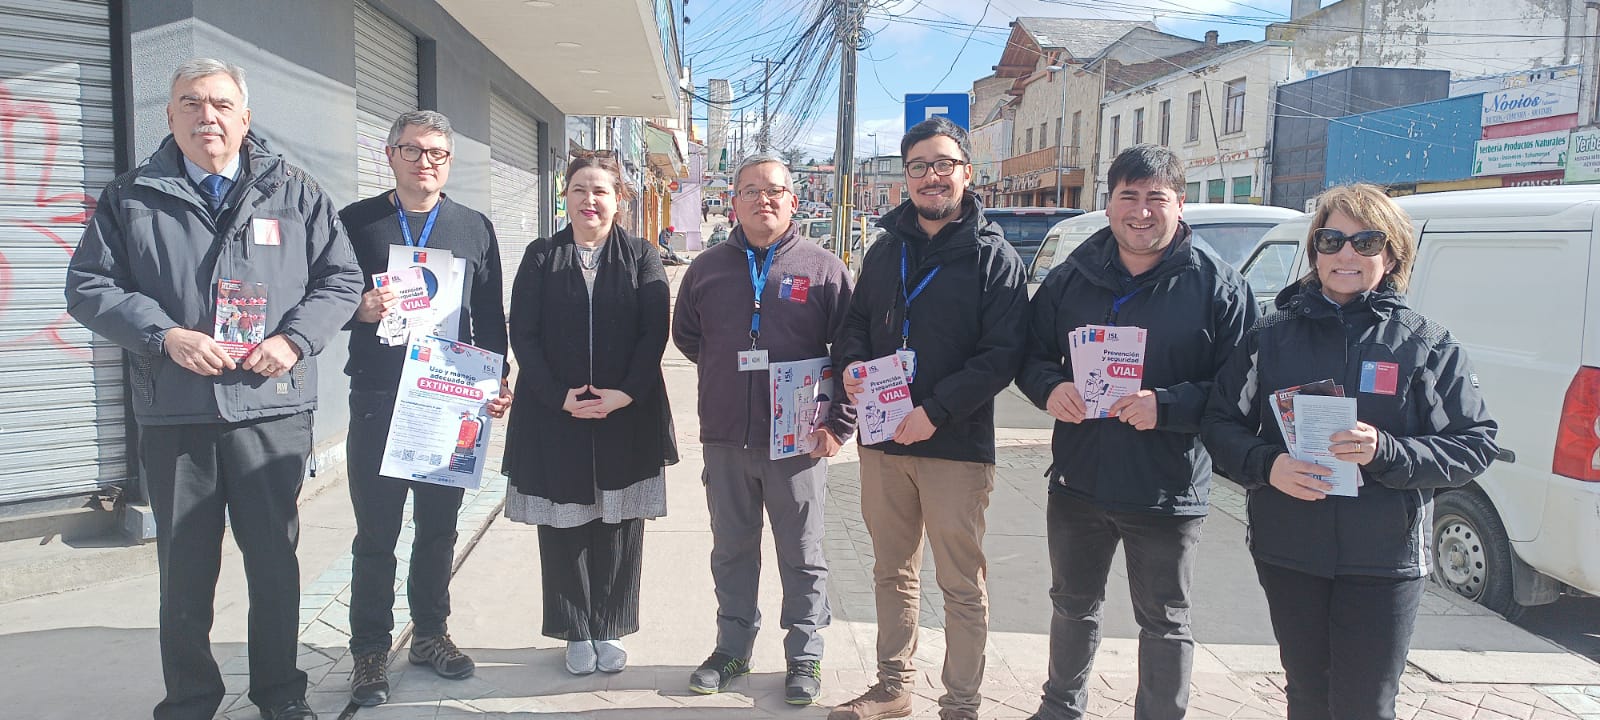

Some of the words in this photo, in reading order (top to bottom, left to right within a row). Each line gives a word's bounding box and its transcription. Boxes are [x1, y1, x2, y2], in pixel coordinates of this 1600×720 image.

[1485, 93, 1541, 113] Novios
[1504, 140, 1533, 151] Productos
[1535, 136, 1566, 148] Naturales
[403, 299, 427, 310] VIAL
[1103, 349, 1139, 358] Prevención
[1107, 356, 1139, 364] seguridad
[429, 365, 443, 374] Uso
[450, 370, 477, 382] manejo
[483, 364, 496, 374] ISL
[1112, 365, 1138, 377] VIAL
[429, 373, 465, 385] adecuado
[870, 375, 902, 387] Prevención
[419, 379, 482, 400] EXTINTORES
[882, 389, 906, 401] VIAL
